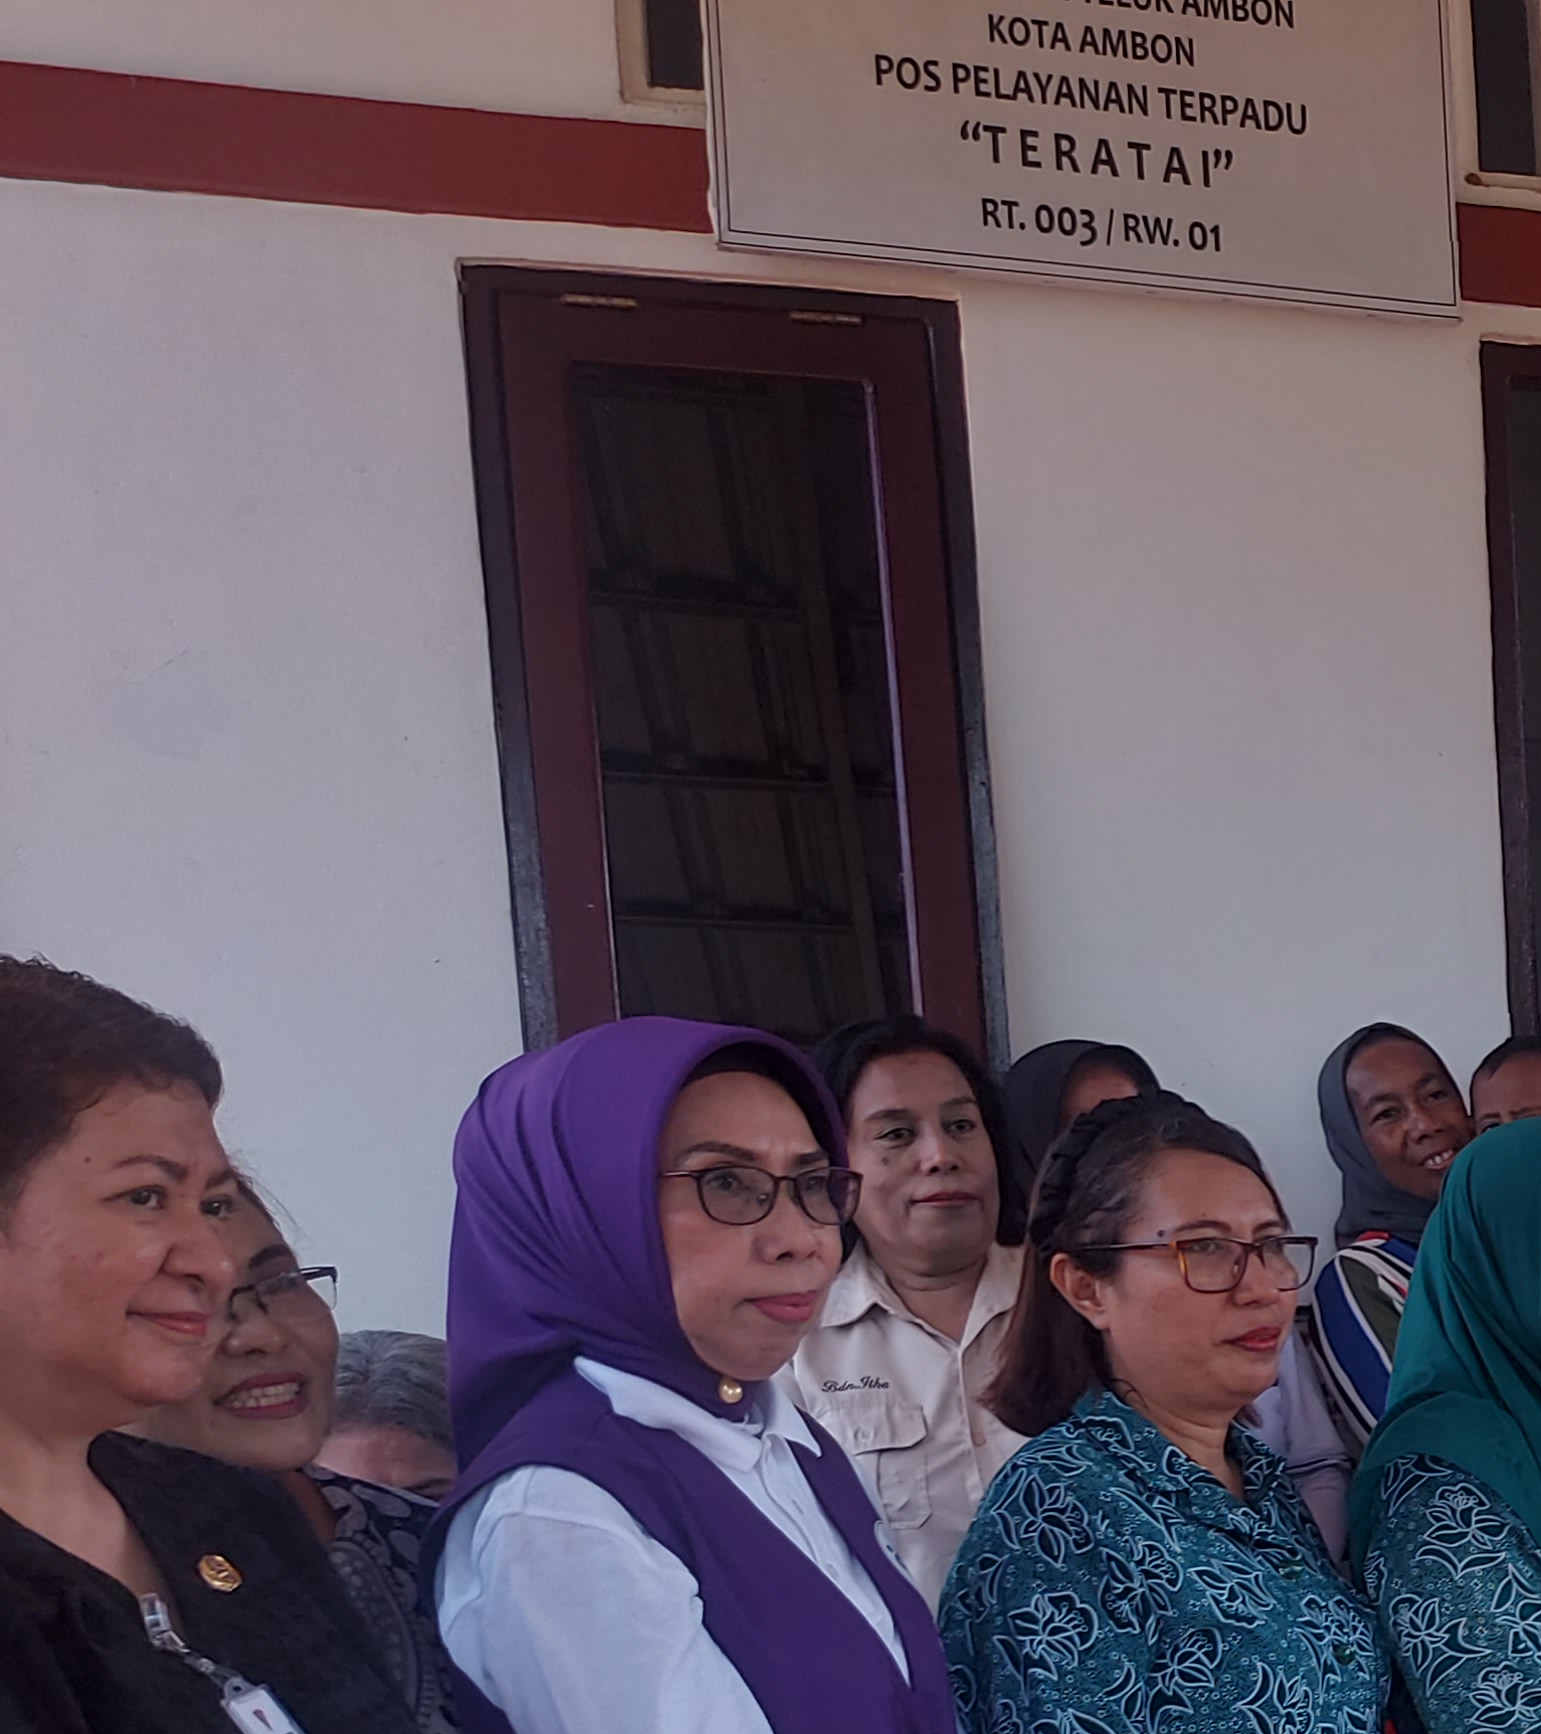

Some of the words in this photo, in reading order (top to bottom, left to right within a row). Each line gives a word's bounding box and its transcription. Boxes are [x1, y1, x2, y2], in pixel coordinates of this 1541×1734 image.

[988, 13, 1072, 52] KOTA
[1079, 25, 1195, 67] AMBON
[874, 54, 941, 93] POS
[951, 62, 1149, 116] PELAYANAN
[1158, 87, 1308, 135] TERPADU
[981, 198, 1026, 231] RT.
[1123, 213, 1180, 248] RW.
[1188, 220, 1222, 252] 01
